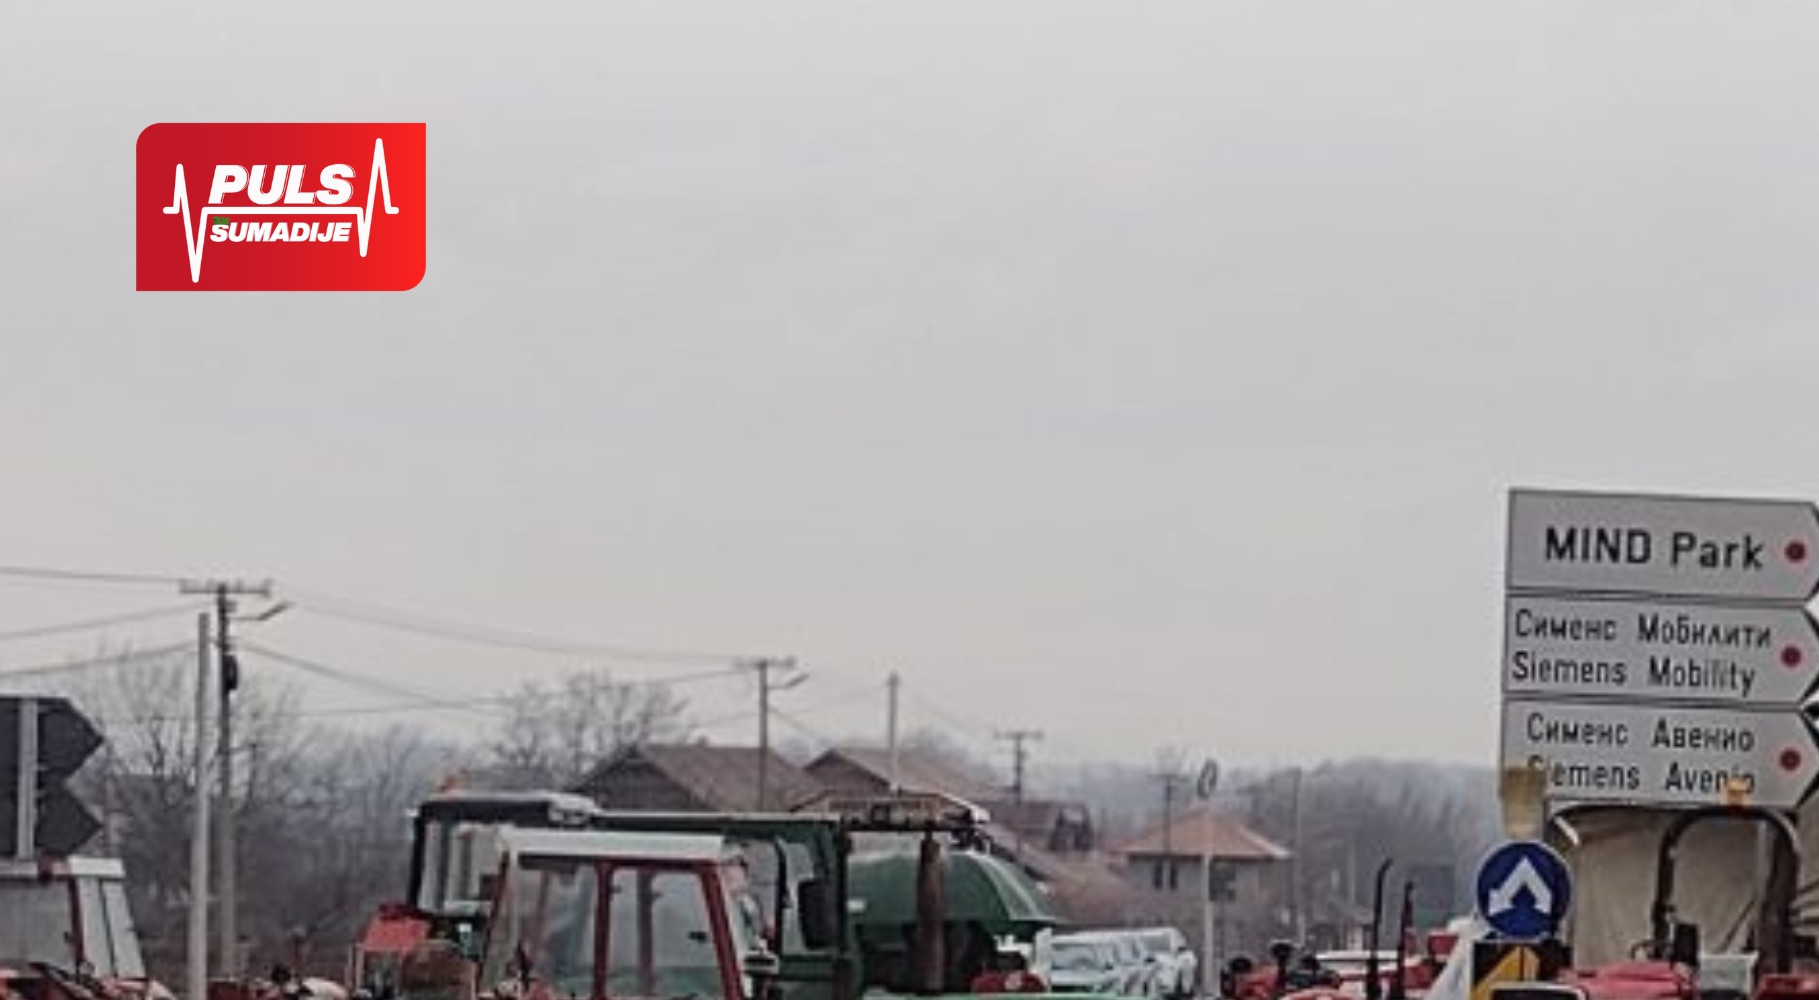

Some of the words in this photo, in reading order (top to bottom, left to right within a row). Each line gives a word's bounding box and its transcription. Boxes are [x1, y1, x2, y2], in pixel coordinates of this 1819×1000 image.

[1545, 526, 1652, 565] MIND
[1670, 531, 1764, 570] Park
[1515, 608, 1617, 642] Сименс
[1637, 612, 1771, 649] Мобилити
[1511, 651, 1628, 686] Siemens
[1647, 656, 1756, 698] Mobility
[1526, 712, 1628, 747] Сименс
[1651, 718, 1755, 752] Авенио
[1664, 761, 1756, 794] Aveno
